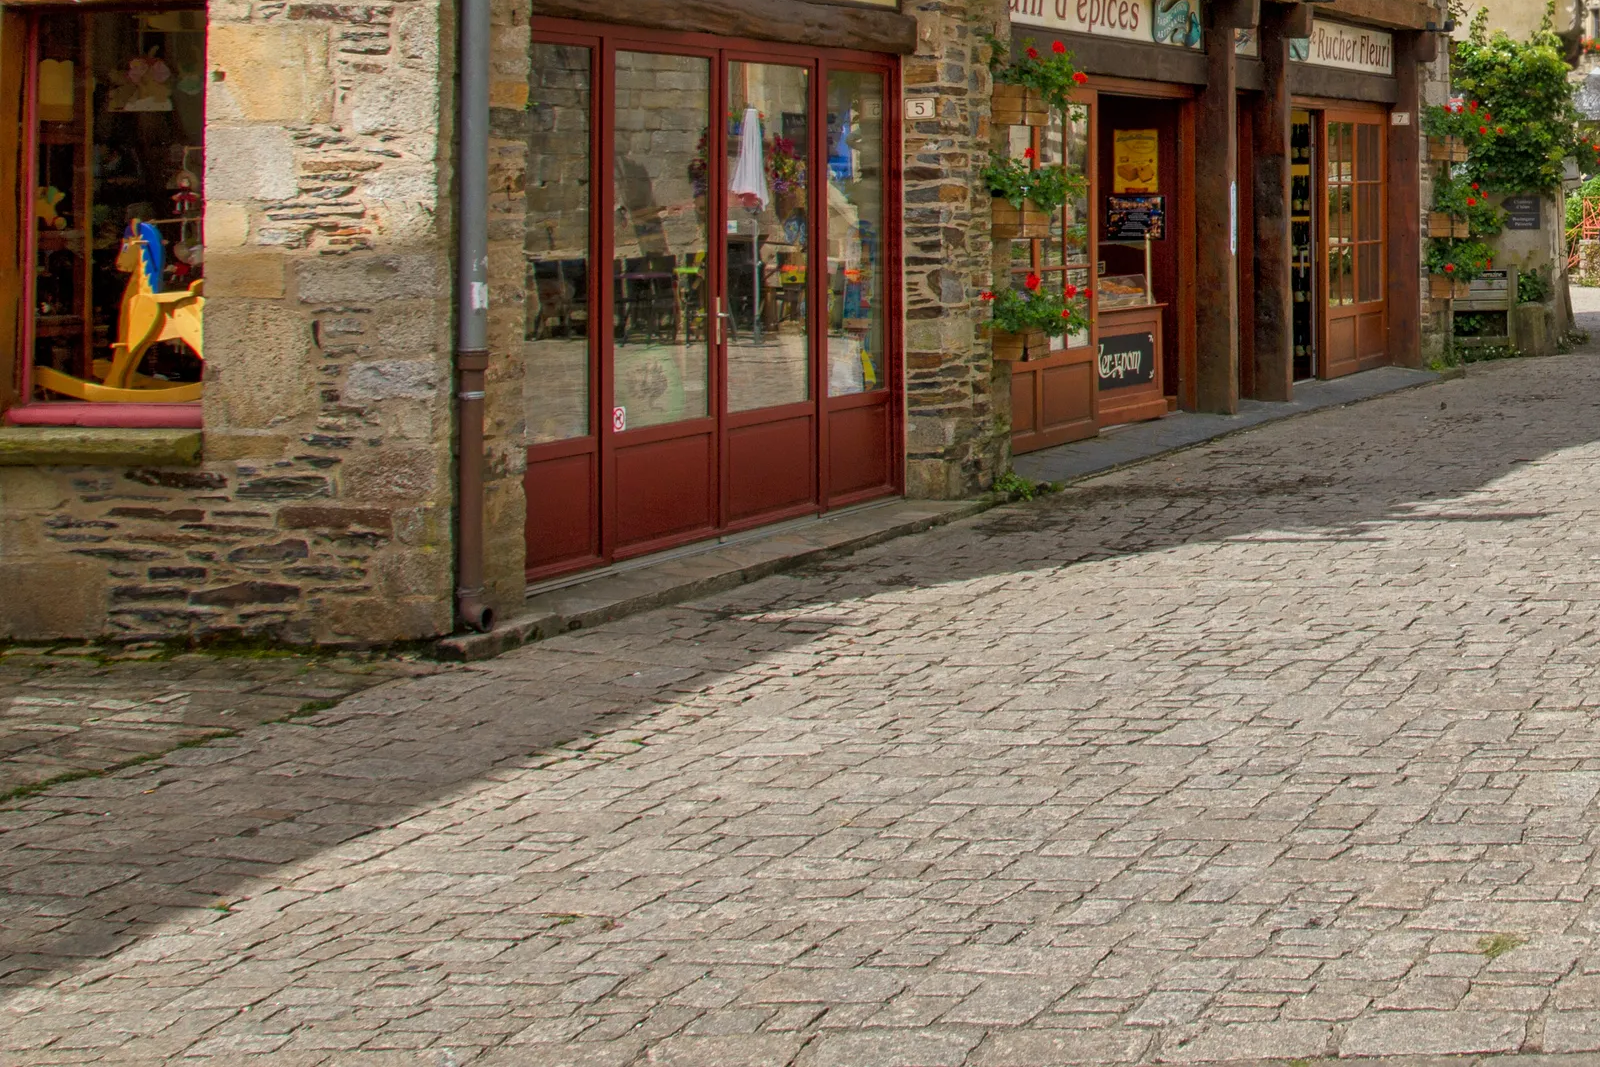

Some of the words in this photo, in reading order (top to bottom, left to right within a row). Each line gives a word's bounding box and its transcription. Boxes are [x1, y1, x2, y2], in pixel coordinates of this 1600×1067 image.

[1317, 28, 1357, 63] Rucher
[1360, 35, 1390, 67] Fleuri
[915, 102, 925, 115] 5
[1397, 115, 1404, 123] 7
